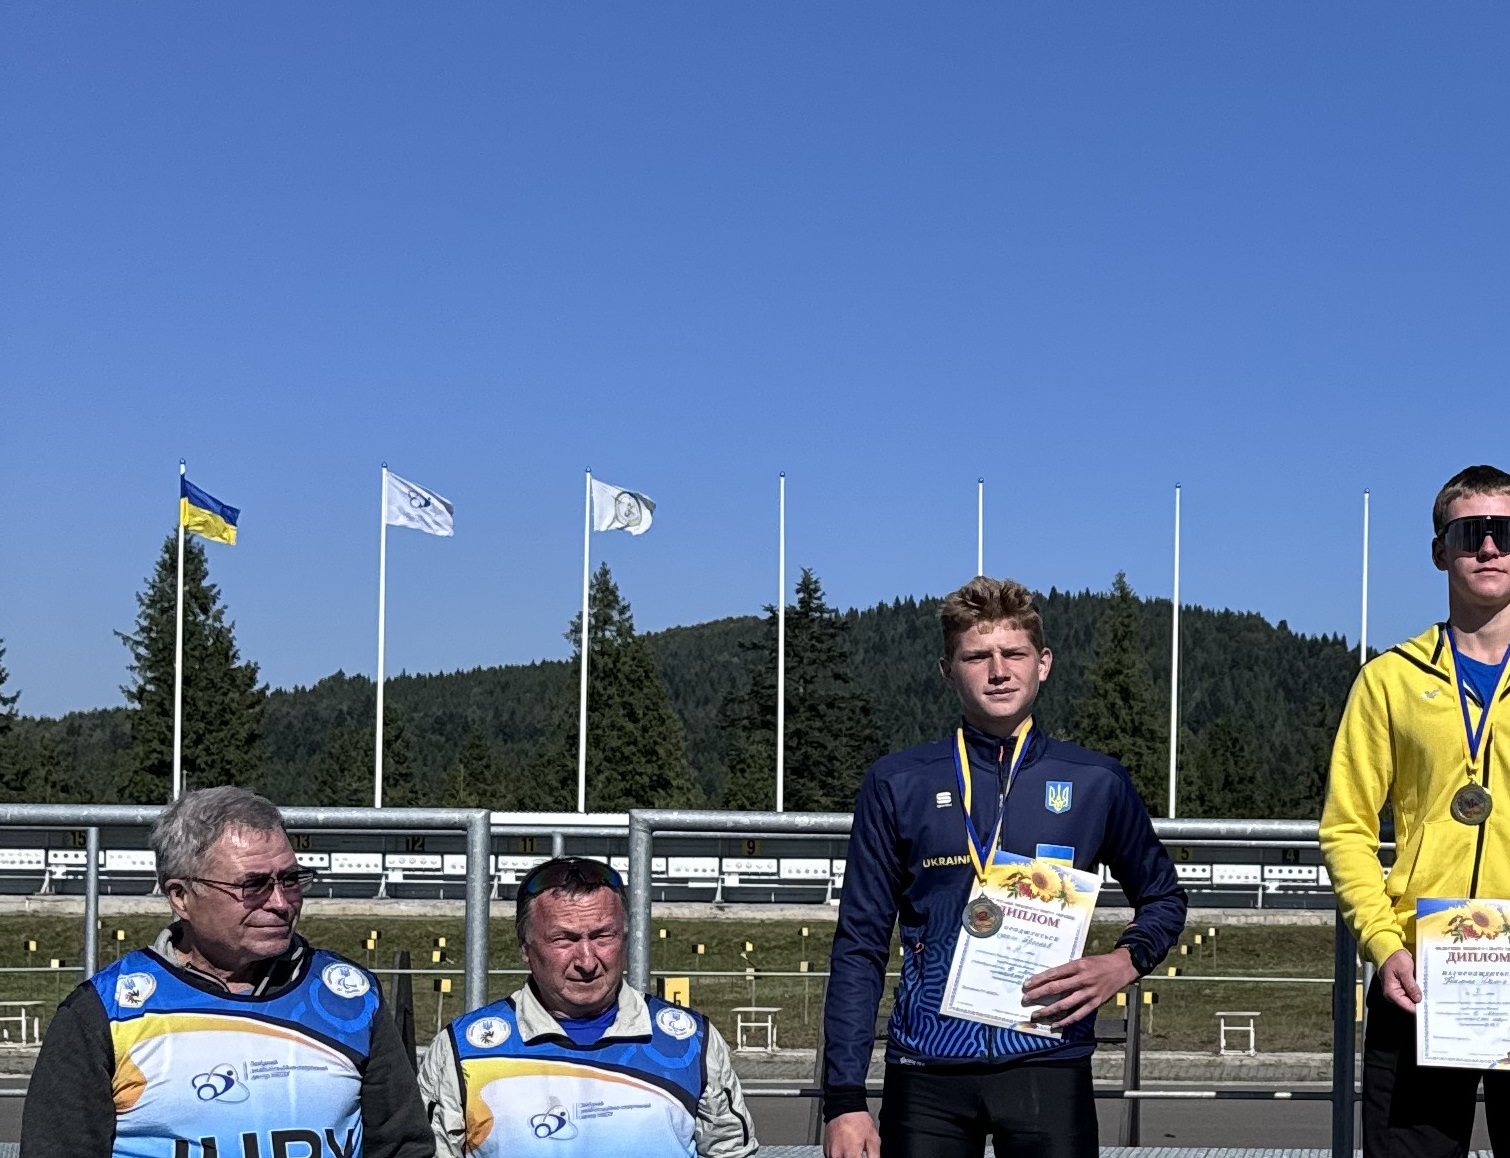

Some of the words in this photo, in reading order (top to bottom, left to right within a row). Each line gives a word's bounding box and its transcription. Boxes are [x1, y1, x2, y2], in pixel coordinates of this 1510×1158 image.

[295, 835, 310, 849] 13
[406, 837, 425, 851] 12
[521, 838, 534, 852] 11
[746, 839, 756, 856] 9
[1181, 847, 1190, 861] 5
[1286, 848, 1295, 864] 4
